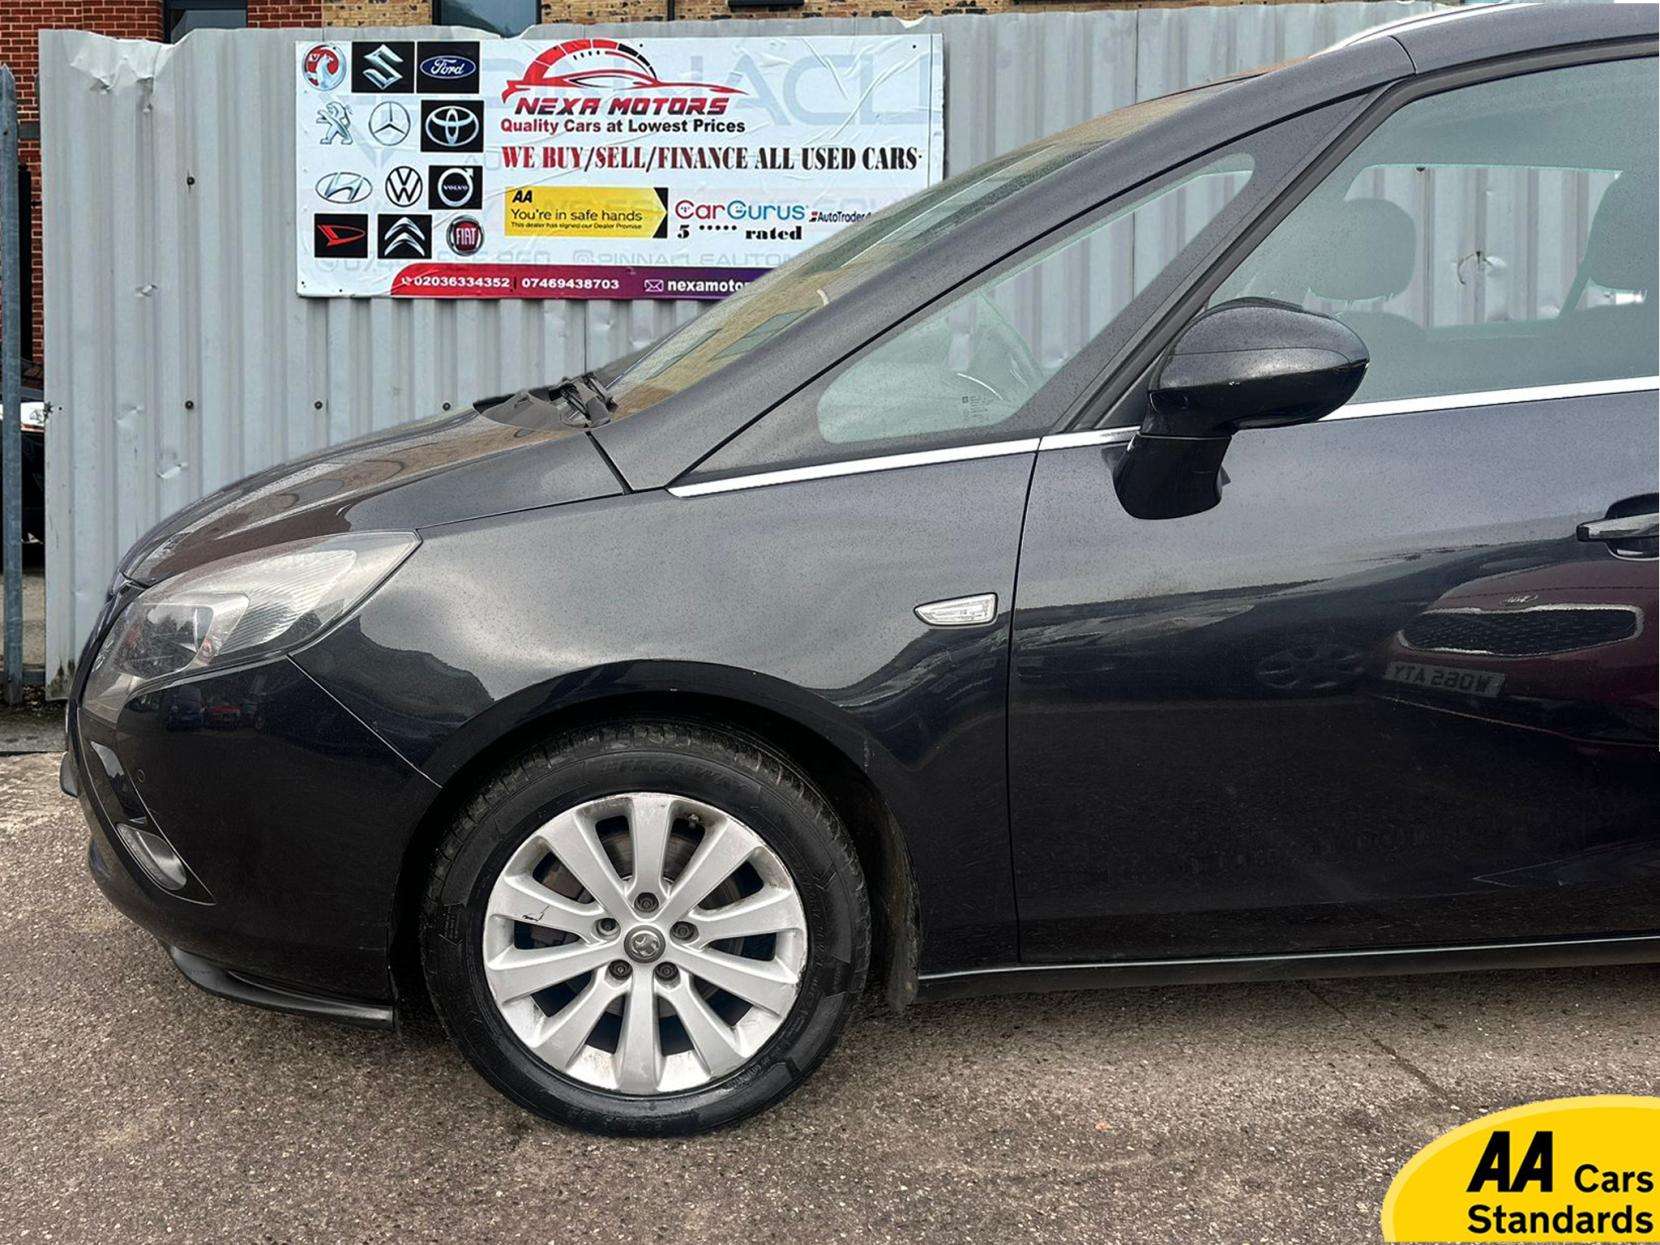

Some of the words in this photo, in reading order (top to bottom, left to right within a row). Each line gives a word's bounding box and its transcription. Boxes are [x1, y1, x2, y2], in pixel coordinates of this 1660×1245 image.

[430, 58, 465, 75] Ford
[515, 98, 600, 115] NEXA
[608, 98, 729, 115] MOTORS
[501, 119, 559, 134] Quality
[564, 119, 600, 132] Cars
[607, 120, 623, 132] at
[628, 119, 688, 132] Lowest
[693, 119, 745, 132] Prices
[502, 146, 535, 169] WE
[542, 146, 748, 172] BUY/SELL/FINANCE
[755, 147, 794, 169] ALL
[801, 147, 856, 170] USED
[862, 147, 918, 170] CARS
[512, 190, 533, 203] AA
[511, 209, 551, 220] You're
[555, 209, 566, 220] in
[570, 209, 598, 221] safe
[602, 209, 643, 221] hands
[675, 200, 805, 220] CarGurus
[817, 211, 865, 222] AutoTrader
[456, 227, 477, 245] FIAT
[677, 224, 690, 239] 5
[745, 226, 802, 240] rated
[414, 277, 510, 288] 02036334352
[522, 278, 619, 289] 07469438703
